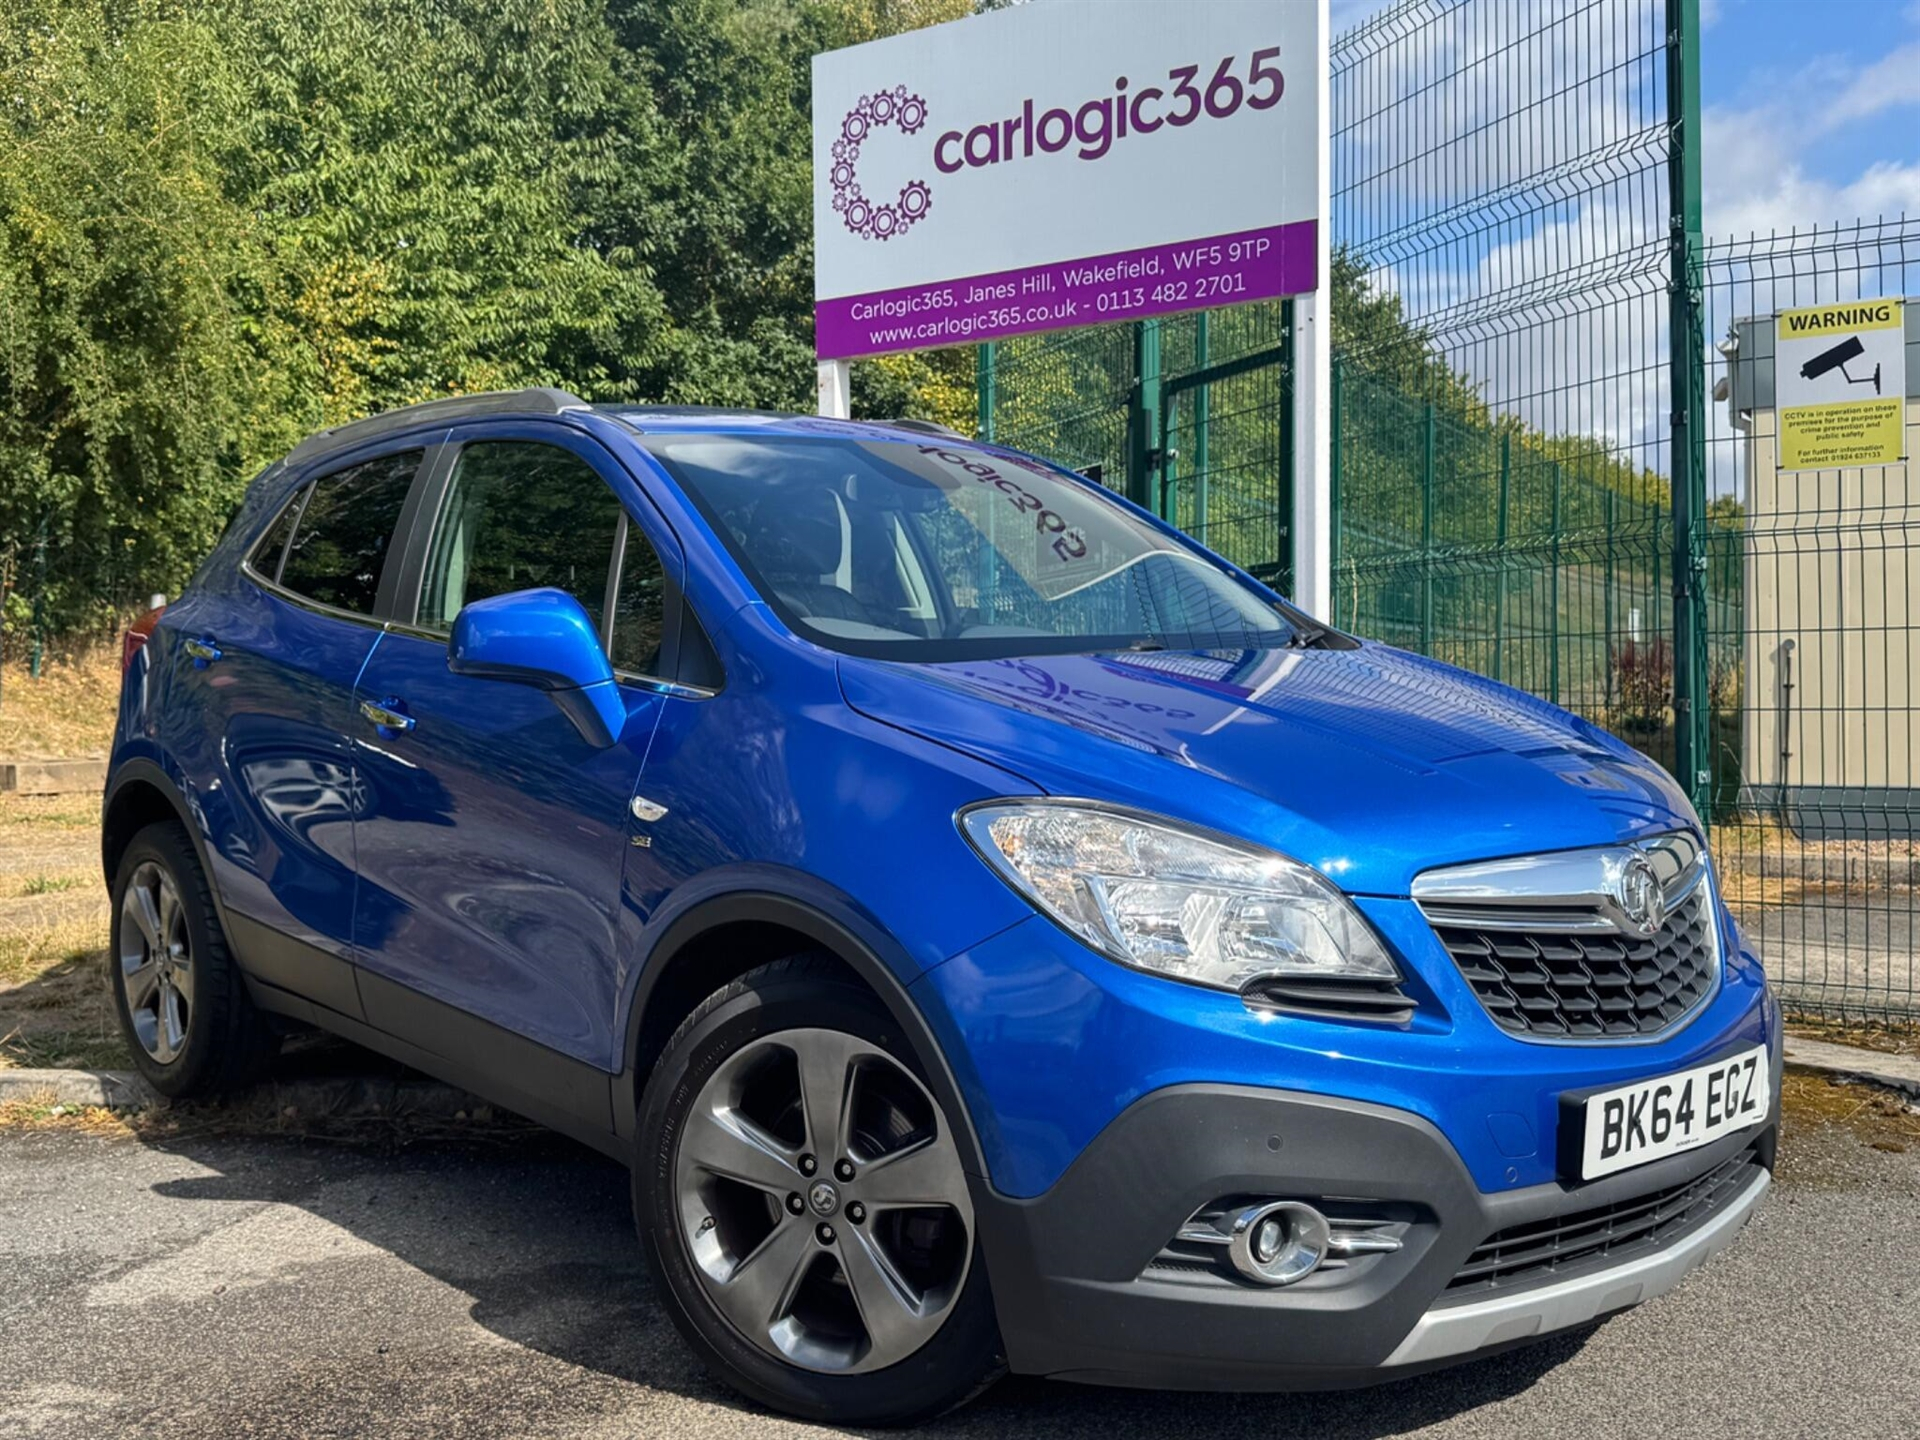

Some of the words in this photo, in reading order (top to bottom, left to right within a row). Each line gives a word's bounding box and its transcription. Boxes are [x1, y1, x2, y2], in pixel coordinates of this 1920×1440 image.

[933, 46, 1286, 174] carlogic365
[850, 289, 959, 323] Carlogic365,
[964, 278, 1017, 305] Janes
[1022, 273, 1057, 295] Hill,
[1063, 255, 1165, 288] Wakefield,
[1172, 245, 1222, 271] WF5
[1228, 237, 1271, 263] 9TP
[869, 302, 1077, 346] www.carlogic365.co.uk
[1097, 290, 1144, 313] 0113
[1151, 282, 1188, 304] 482
[1194, 272, 1246, 297] 2701
[1789, 306, 1890, 331] WARNING
[1785, 411, 1806, 419] CCTV
[1825, 407, 1861, 418] operation
[1876, 403, 1897, 411] these
[1788, 418, 1822, 428] premises
[1824, 416, 1836, 425] for
[1837, 415, 1849, 423] the
[1851, 413, 1883, 424] purpose
[1885, 411, 1893, 419] of
[1800, 426, 1821, 434] crime
[1823, 422, 1864, 434] prevention
[1866, 421, 1880, 429] and
[1816, 432, 1840, 441] public
[1841, 430, 1864, 440] safety
[1798, 449, 1810, 457] For
[1812, 447, 1838, 456] further
[1840, 444, 1884, 454] information
[1800, 455, 1829, 464] contact
[1600, 1078, 1695, 1160] BK64
[1706, 1056, 1758, 1129] EGZ
